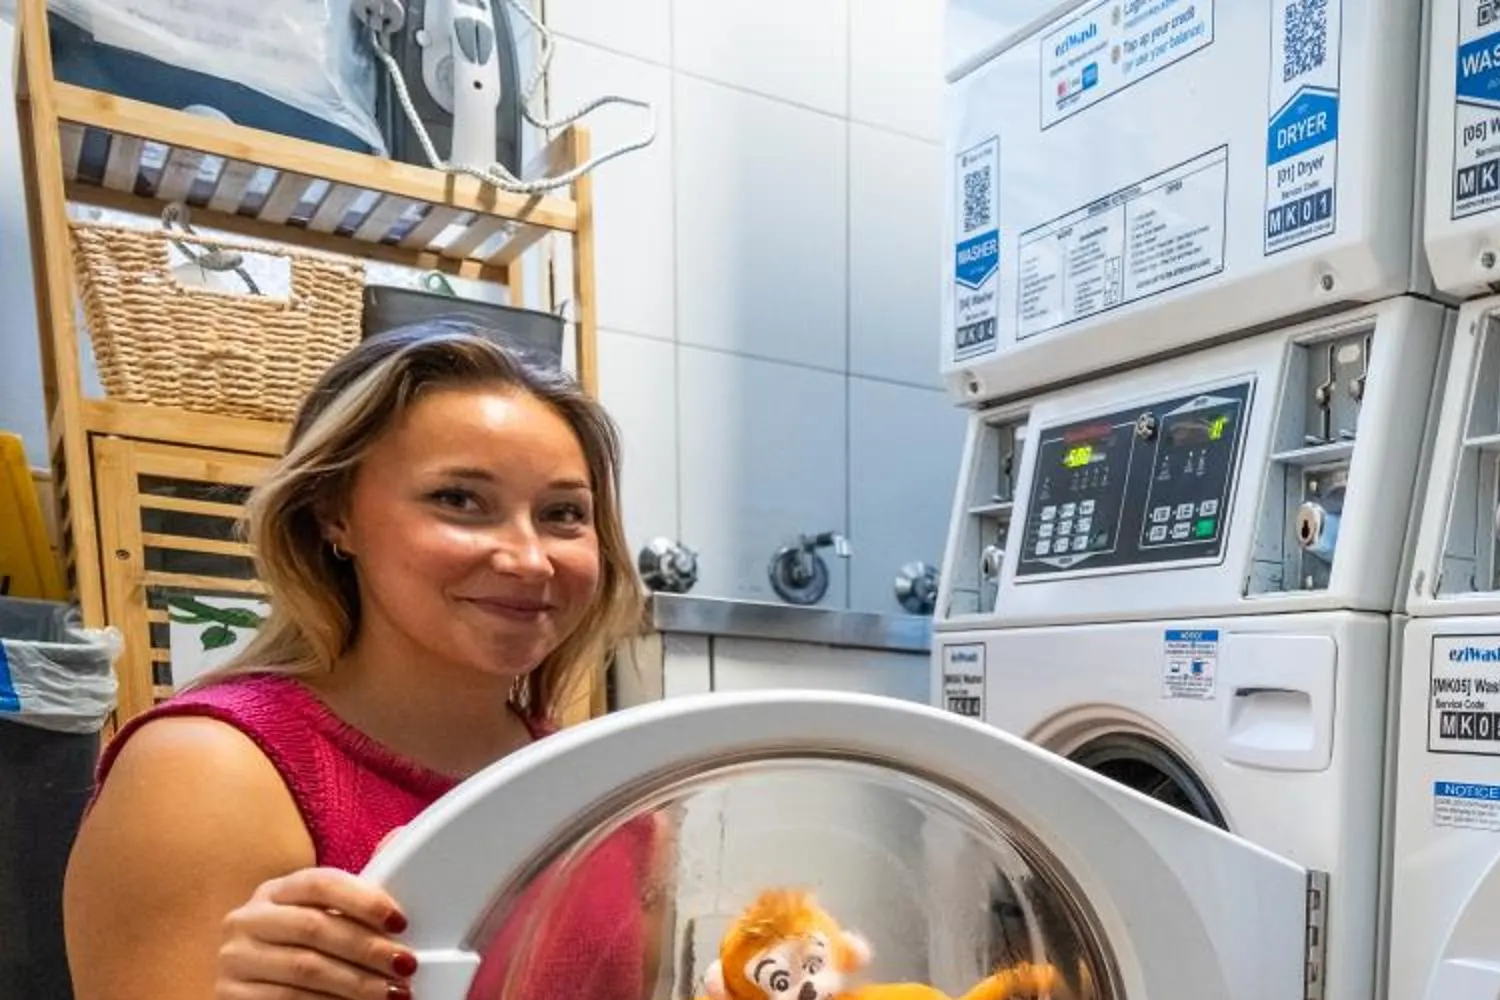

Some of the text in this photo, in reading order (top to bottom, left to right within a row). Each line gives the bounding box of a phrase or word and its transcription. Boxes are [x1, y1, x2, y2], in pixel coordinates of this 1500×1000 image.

[1277, 111, 1328, 150] DRYER
[1463, 121, 1487, 147] [05]
[1297, 154, 1324, 177] Dryer
[1445, 783, 1499, 800] NOTICE
